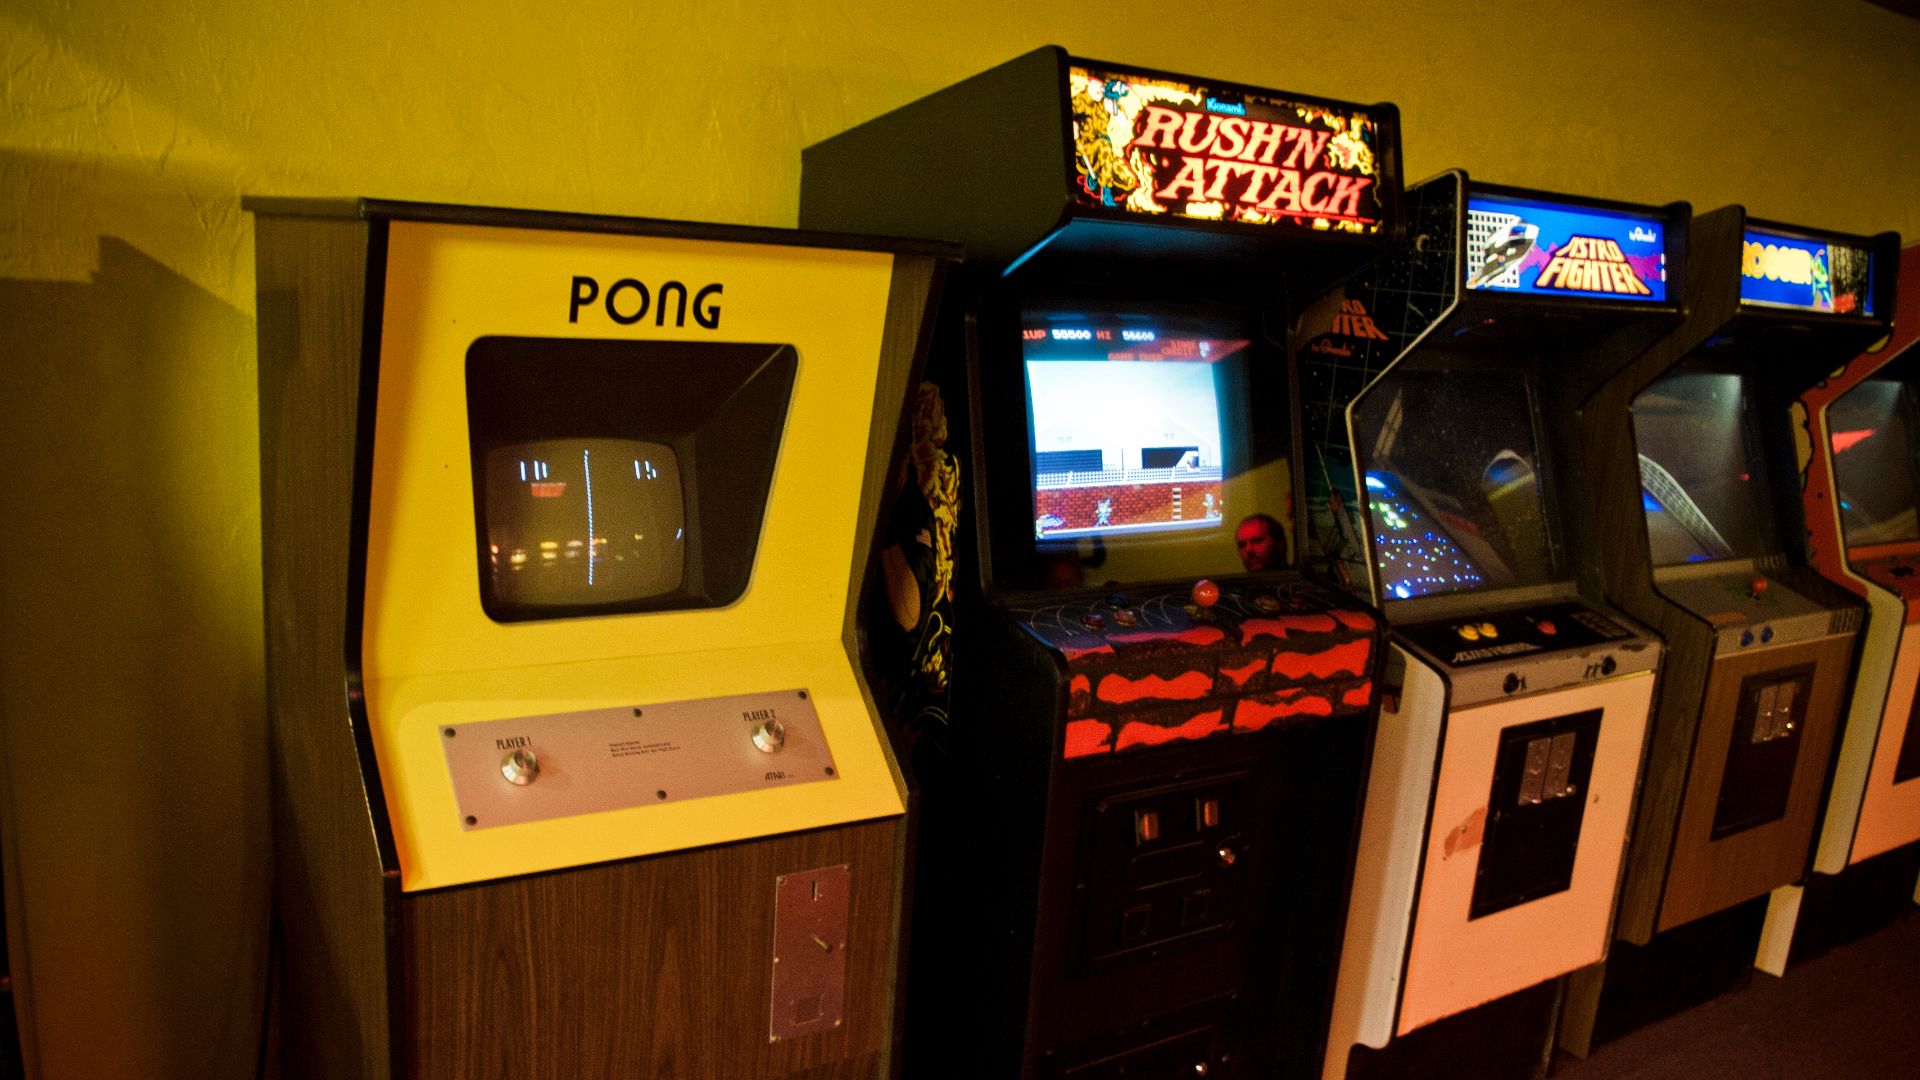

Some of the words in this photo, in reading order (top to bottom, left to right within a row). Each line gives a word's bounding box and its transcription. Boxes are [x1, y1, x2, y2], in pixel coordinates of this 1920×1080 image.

[1133, 105, 1332, 171] RUSH'N
[1155, 156, 1373, 217] ATTACK
[1555, 235, 1626, 263] ASTRO
[1535, 257, 1652, 295] FIGHTER
[569, 275, 724, 330] PONG
[742, 709, 770, 722] PLAYER
[495, 736, 527, 750] PLAYER
[526, 735, 532, 747] 1
[765, 771, 786, 781] ATARI
